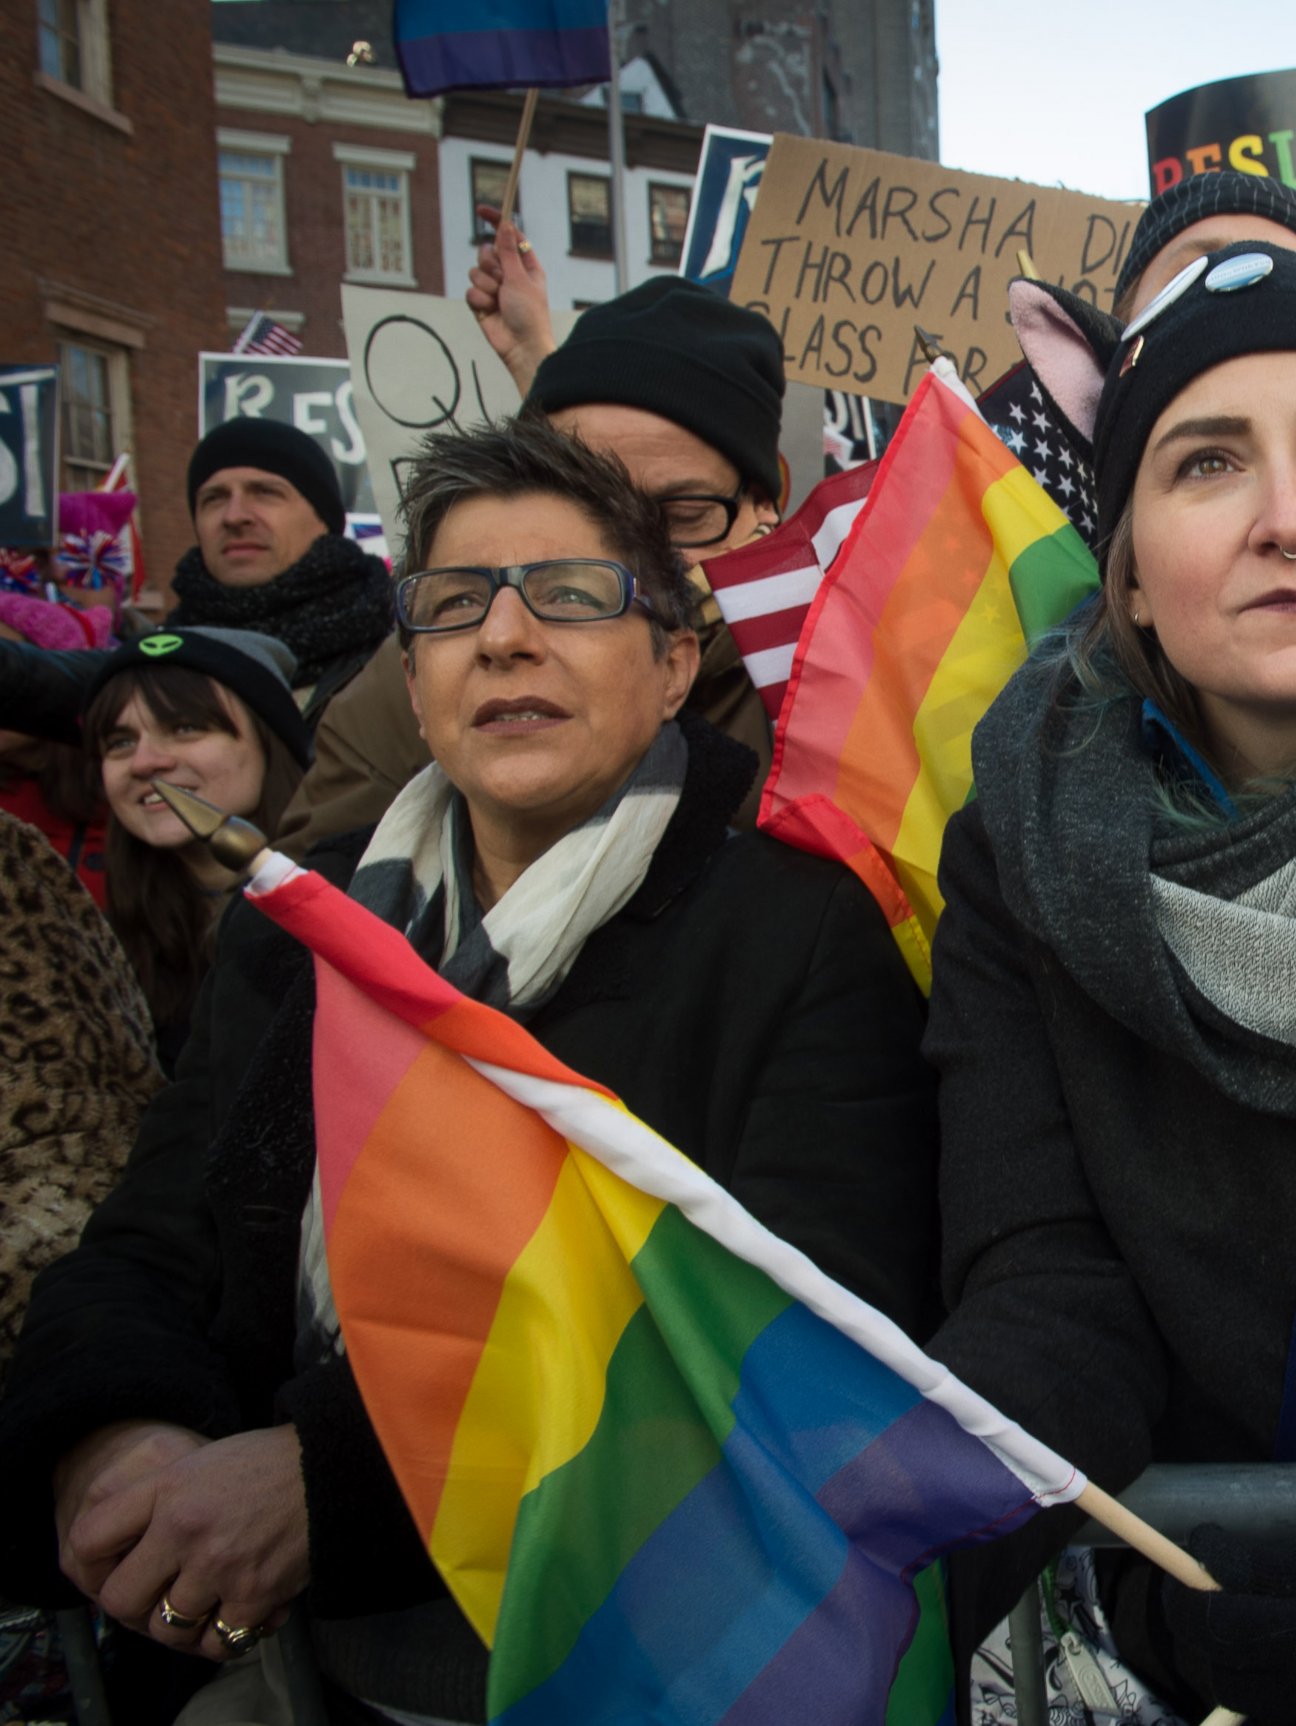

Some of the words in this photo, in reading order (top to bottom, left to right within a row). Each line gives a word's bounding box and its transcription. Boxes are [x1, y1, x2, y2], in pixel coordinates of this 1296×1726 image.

[796, 158, 1038, 259] MARSHA
[1081, 213, 1131, 276] DI
[761, 235, 936, 310] THROW
[950, 264, 983, 321] A
[743, 301, 883, 384] LASS
